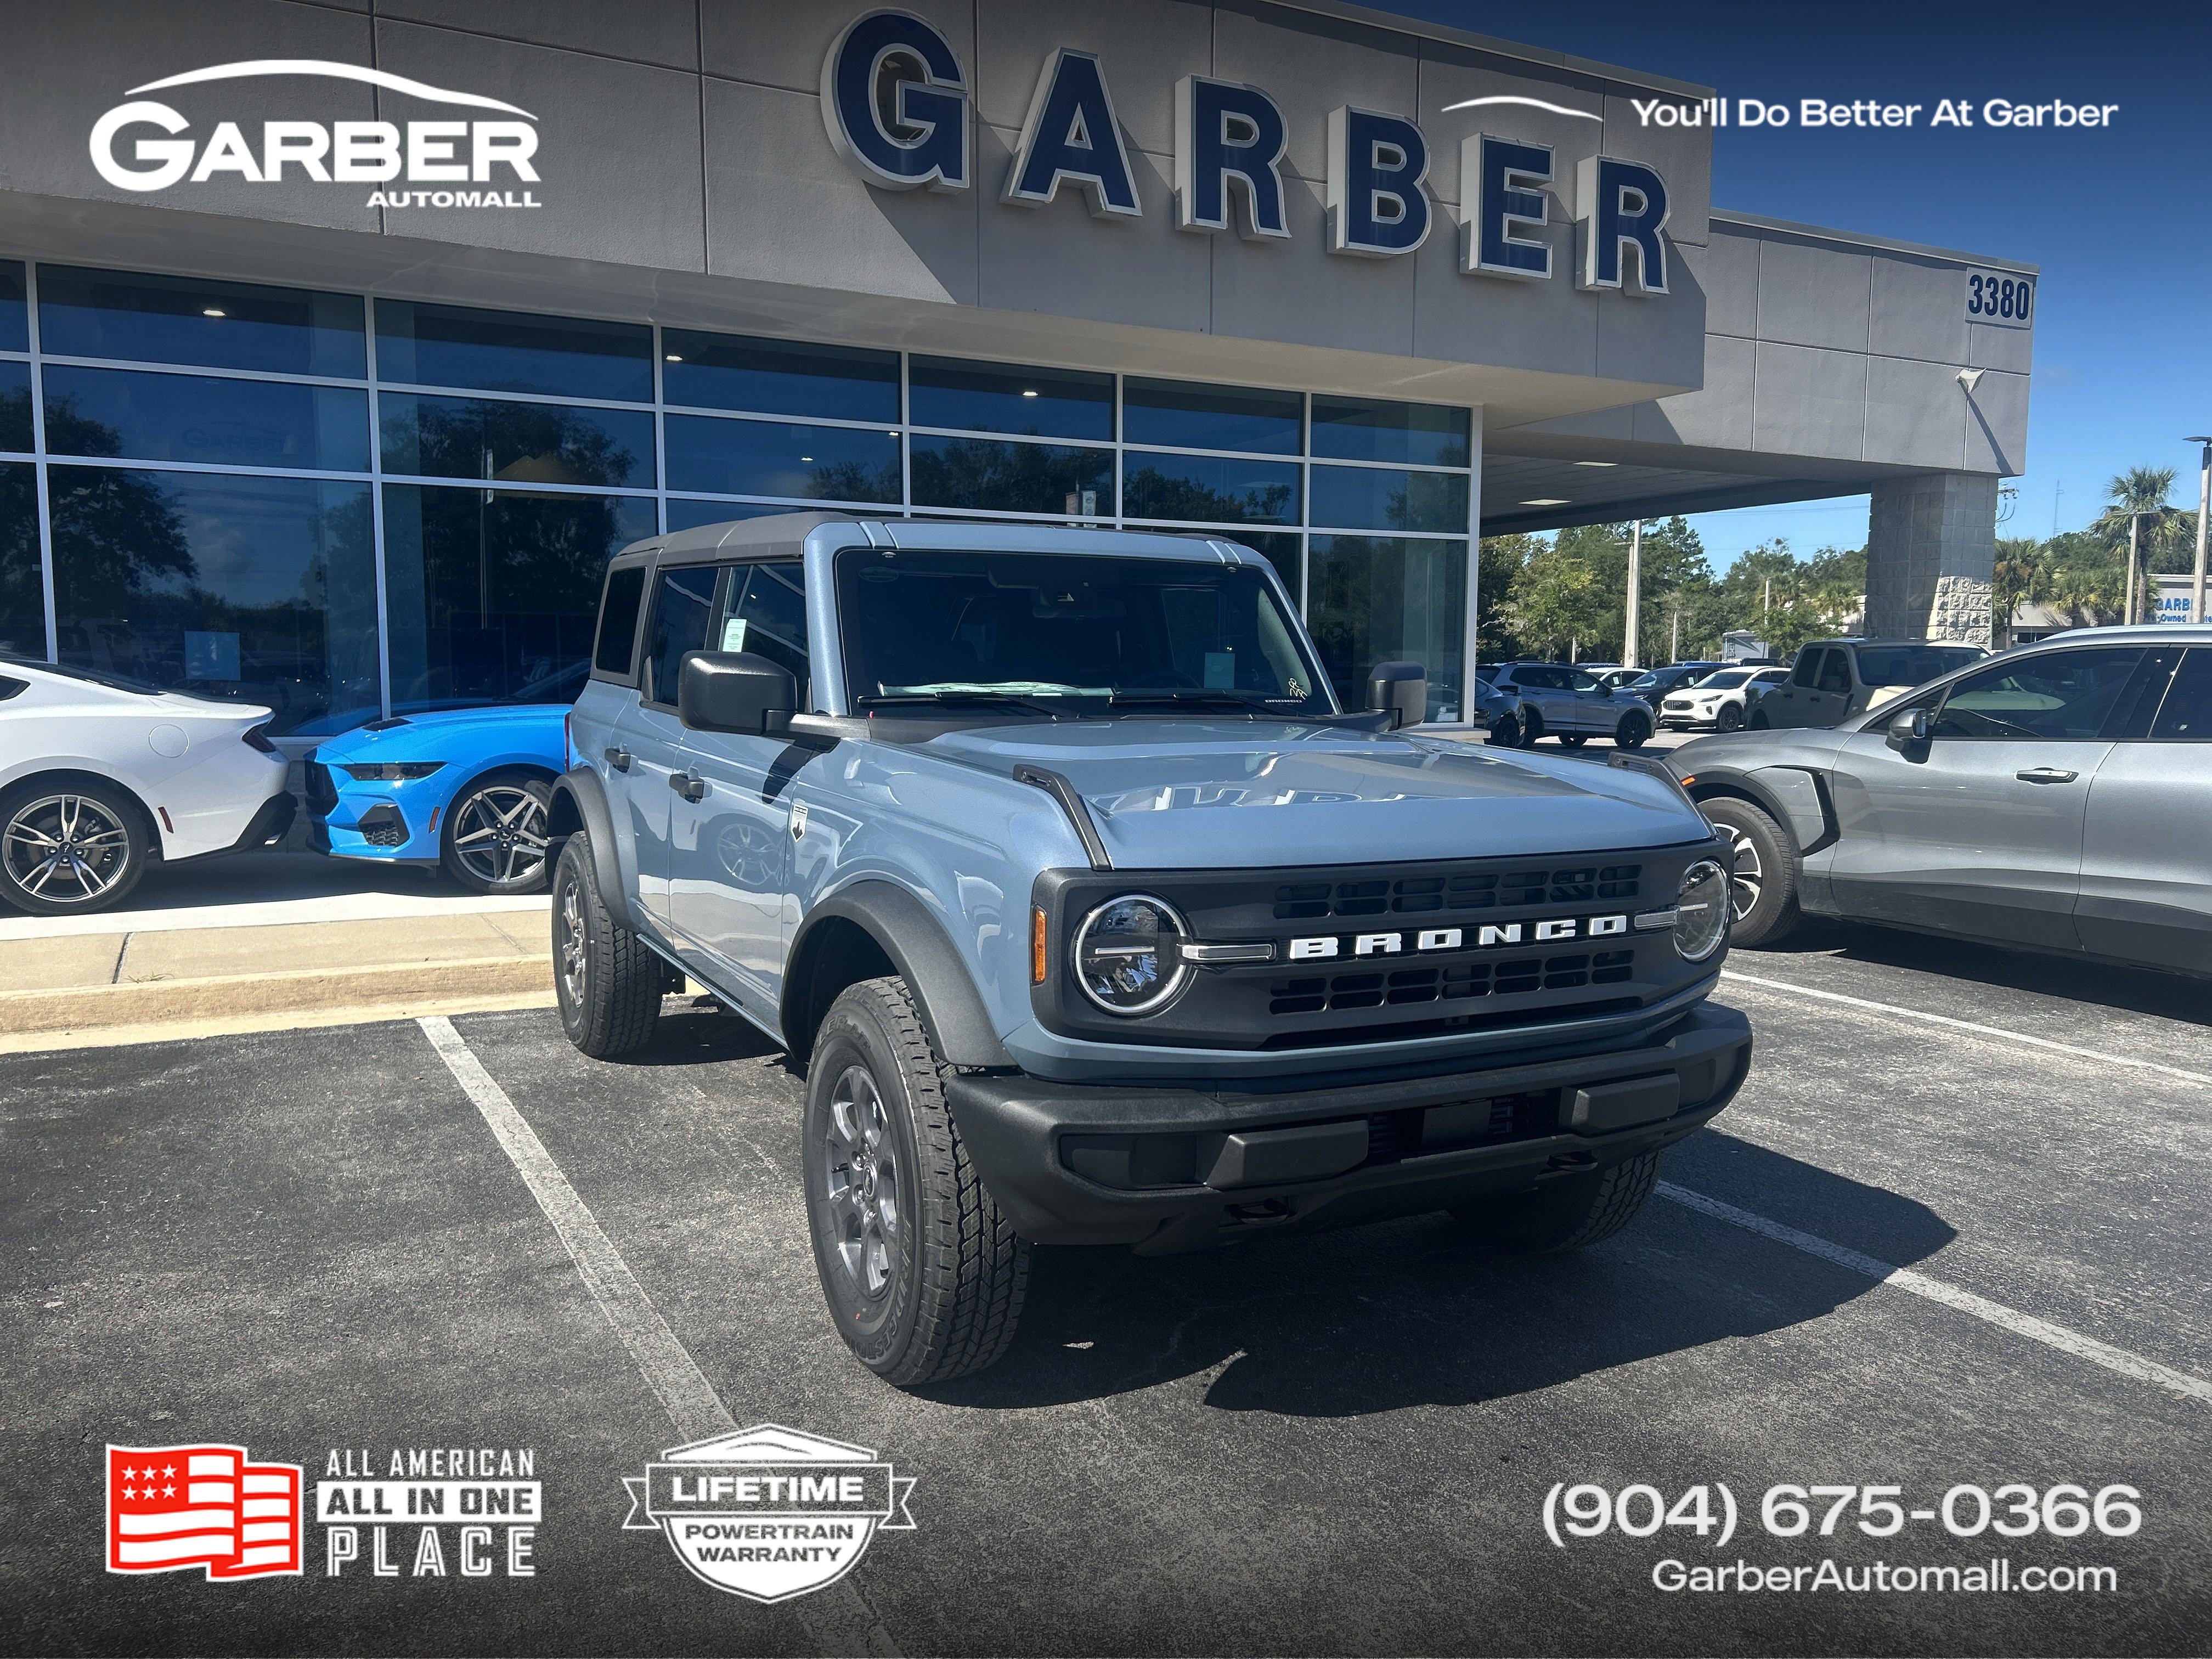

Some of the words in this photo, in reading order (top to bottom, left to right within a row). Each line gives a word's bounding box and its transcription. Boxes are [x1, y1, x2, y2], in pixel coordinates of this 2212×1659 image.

[821, 7, 1671, 296] GARBER
[1968, 274, 2029, 320] 3380
[1290, 915, 1627, 959] BRONCO
